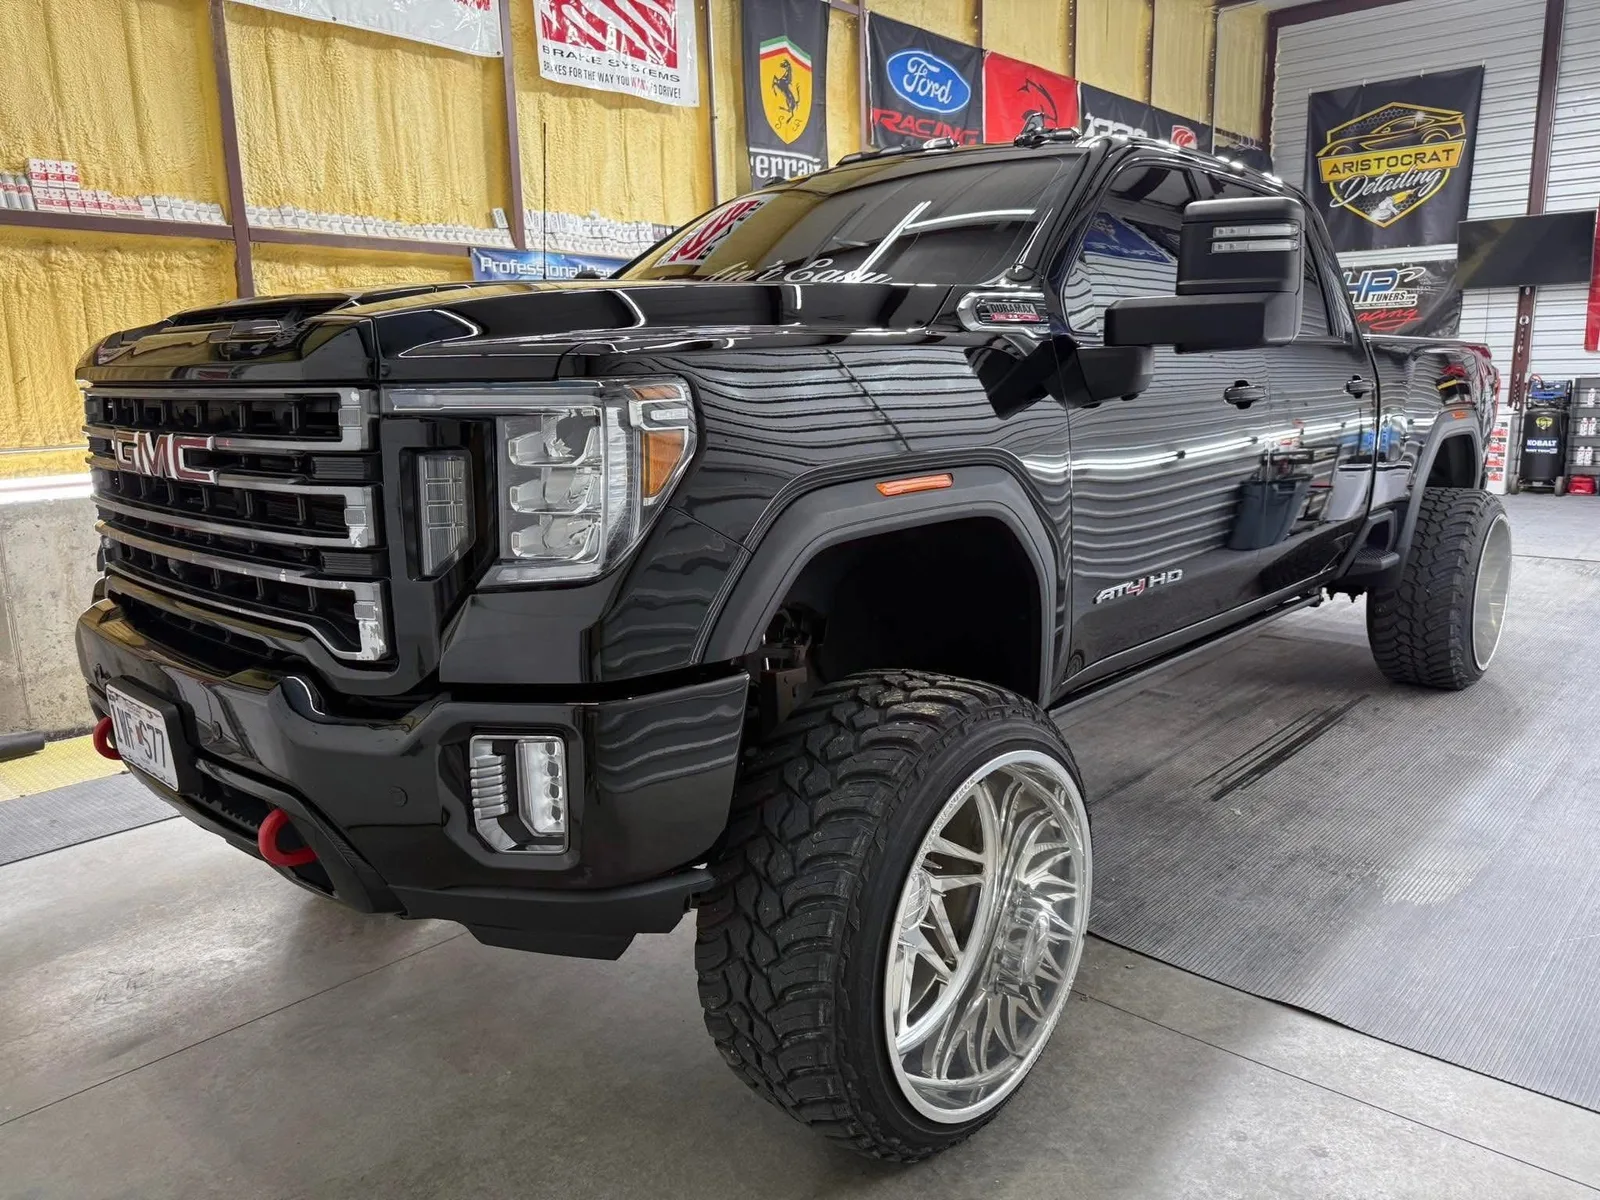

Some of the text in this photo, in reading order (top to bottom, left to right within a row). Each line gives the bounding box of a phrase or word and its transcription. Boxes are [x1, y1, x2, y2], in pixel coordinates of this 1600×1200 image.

[568, 66, 583, 79] FOR
[584, 70, 595, 80] THE
[597, 72, 614, 84] WAY
[616, 74, 630, 86] YOU
[630, 77, 649, 91] WAN
[658, 84, 681, 98] DRIVE!
[902, 57, 952, 104] Ford
[872, 108, 979, 147] RACING
[1328, 148, 1455, 176] ARISTOCRAT
[1329, 164, 1444, 208] Detailing
[479, 256, 583, 279] Professional
[1343, 267, 1400, 304] HP
[989, 303, 1035, 314] DURAMAX
[113, 429, 218, 485] GMC
[1526, 439, 1558, 448] KOBALT
[1093, 568, 1183, 605] AT4 HD
